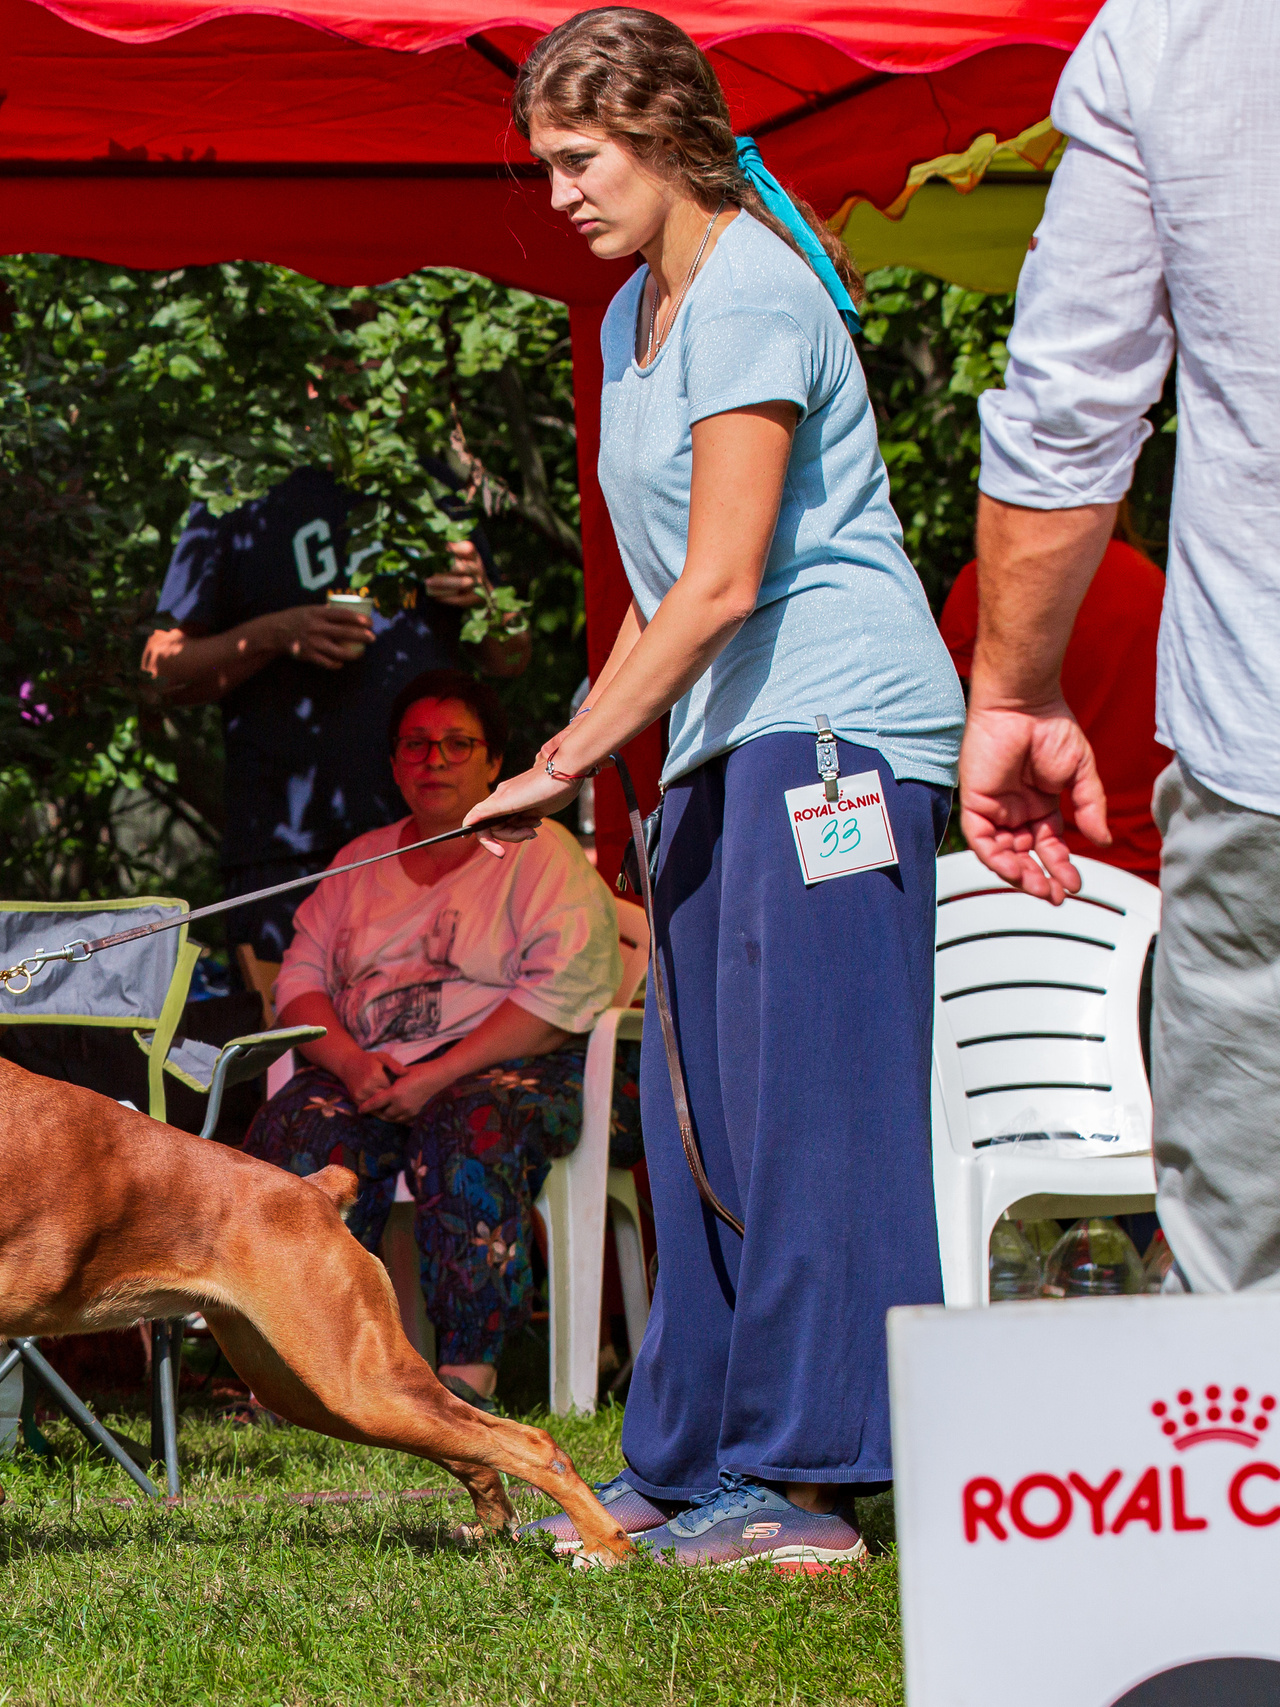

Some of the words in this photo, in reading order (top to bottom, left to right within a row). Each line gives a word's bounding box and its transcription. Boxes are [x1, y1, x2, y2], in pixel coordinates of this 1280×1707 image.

[793, 803, 836, 823] ROYAL
[837, 792, 881, 812] CANIN
[819, 818, 861, 858] 33
[961, 1464, 1209, 1544] ROYAL
[1228, 1460, 1280, 1529] C
